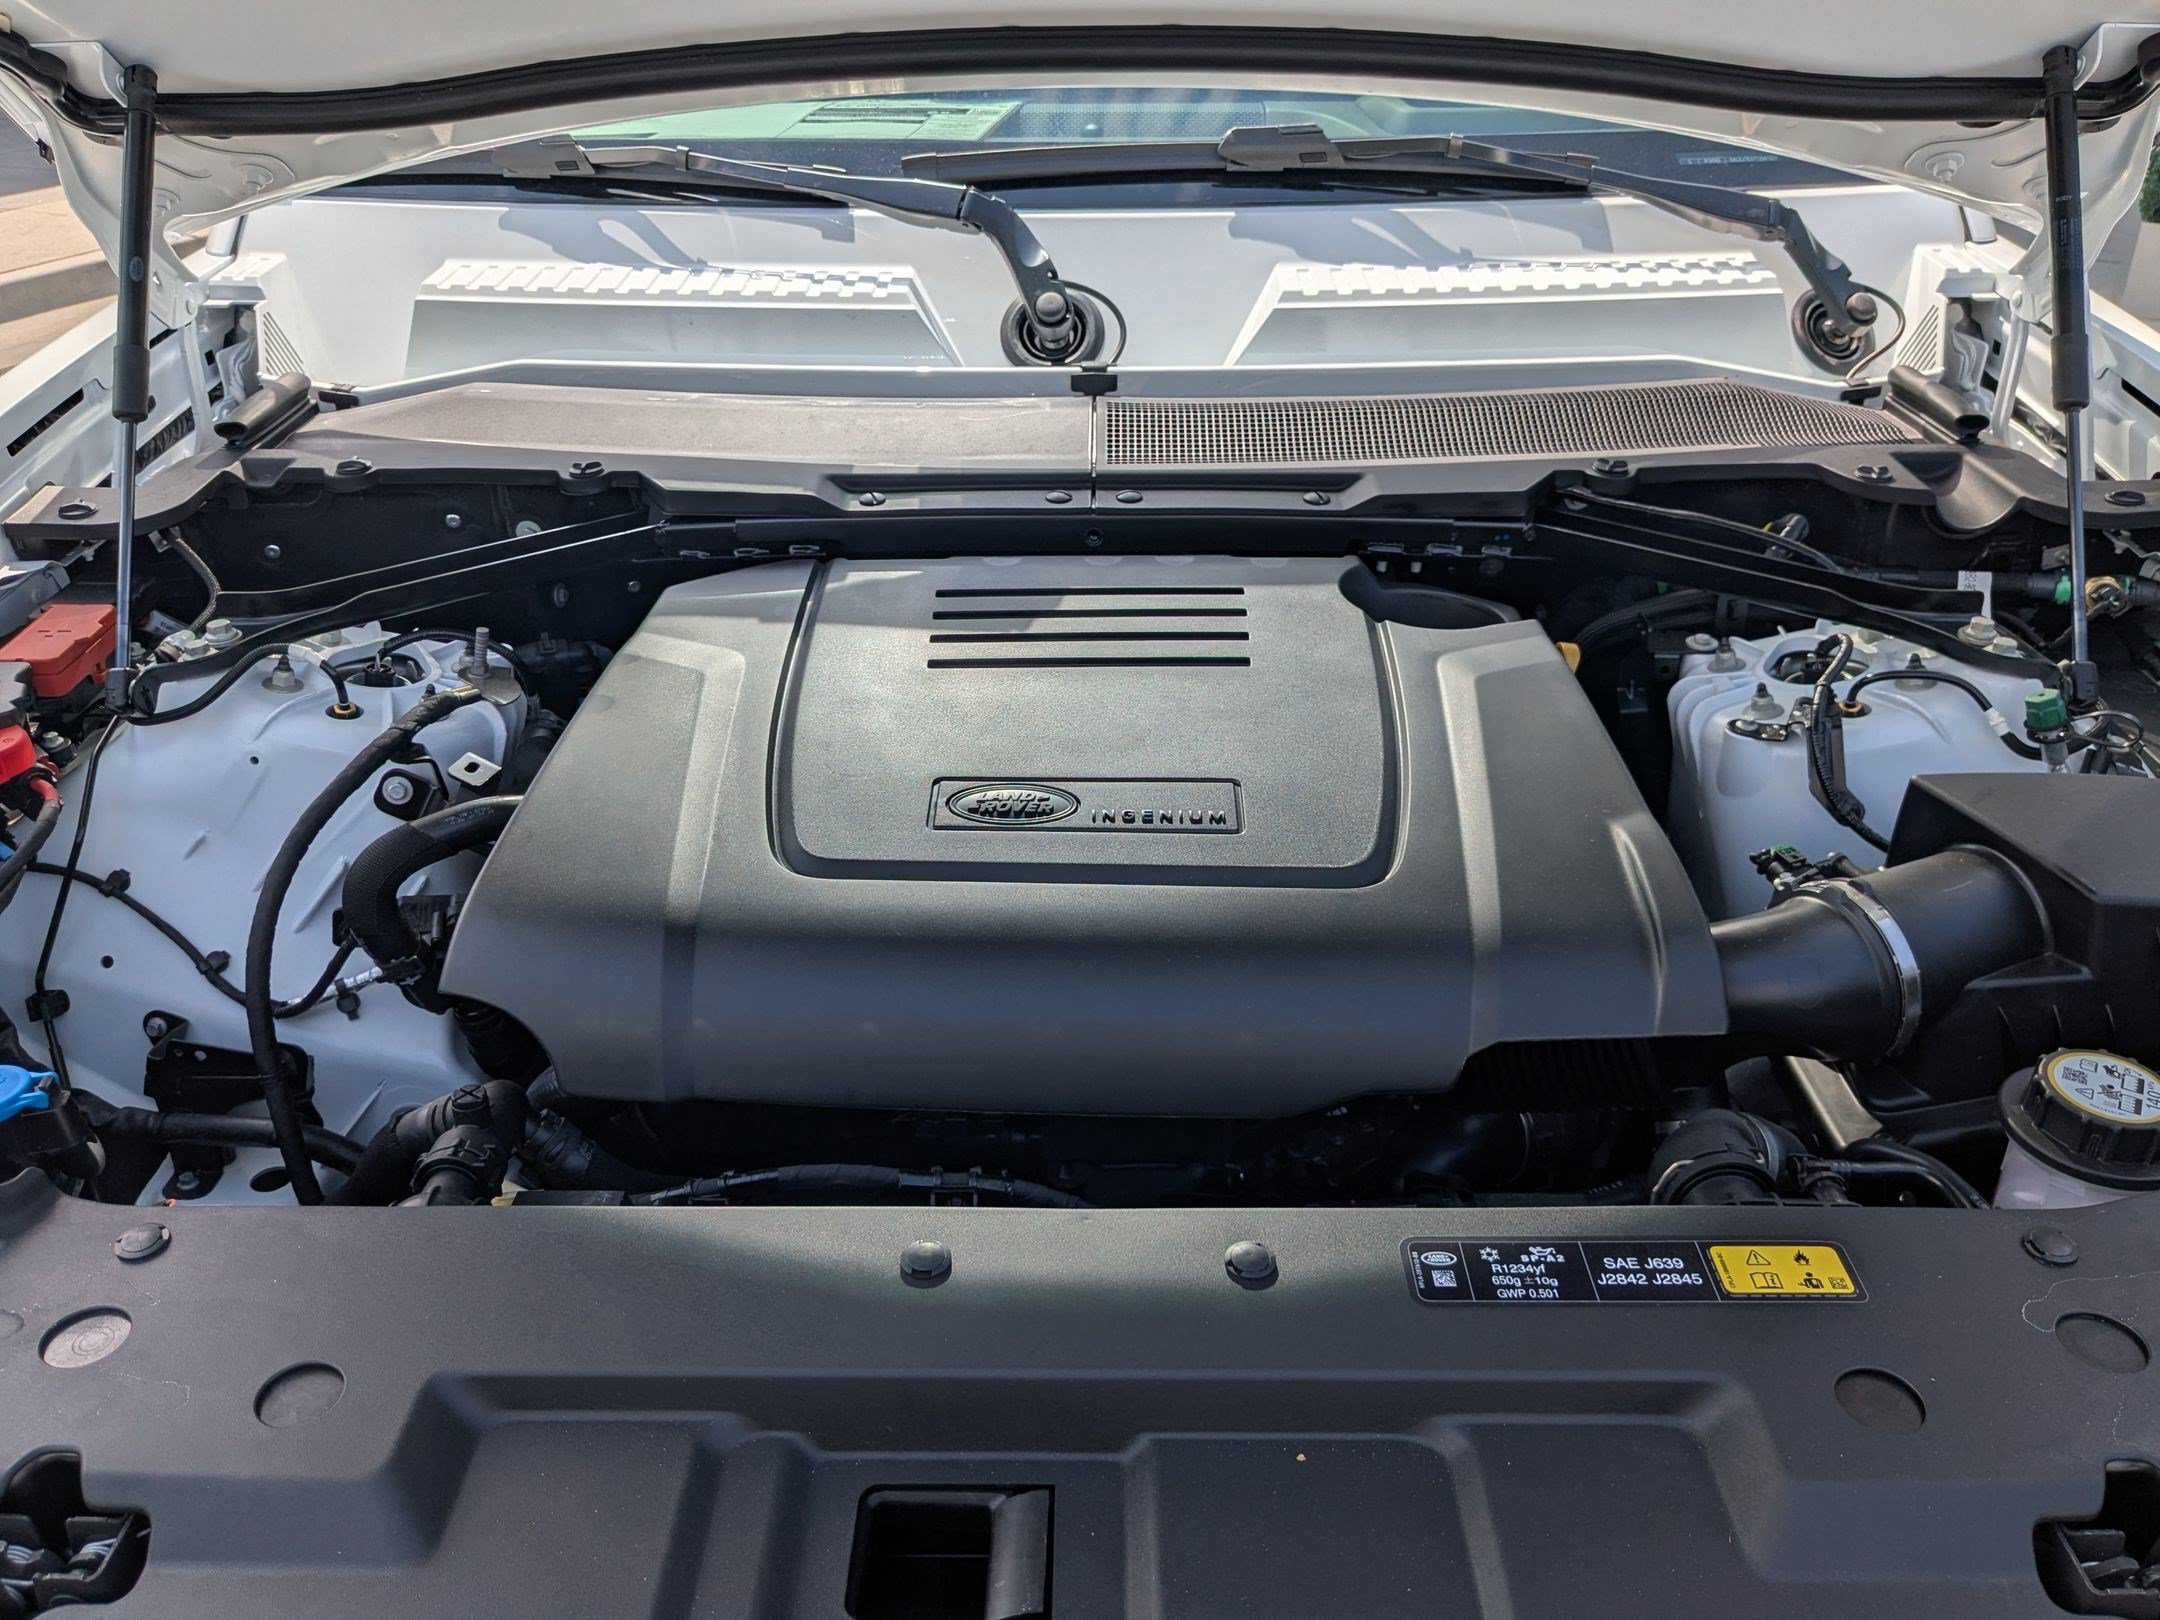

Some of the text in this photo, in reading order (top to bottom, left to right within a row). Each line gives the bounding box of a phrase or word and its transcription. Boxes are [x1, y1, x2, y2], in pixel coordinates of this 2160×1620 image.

[977, 791, 1038, 803] LAND
[979, 800, 1054, 818] ROVER
[1091, 809, 1227, 825] INGENIUM
[1520, 1254, 1566, 1263] SP-A2
[1603, 1257, 1684, 1270] SAE J639
[1491, 1263, 1546, 1275] R1234yf
[1491, 1275, 1522, 1287] 650g
[1597, 1273, 1704, 1285] J2842 J2845
[1496, 1288, 1560, 1299] GWP 0.501
